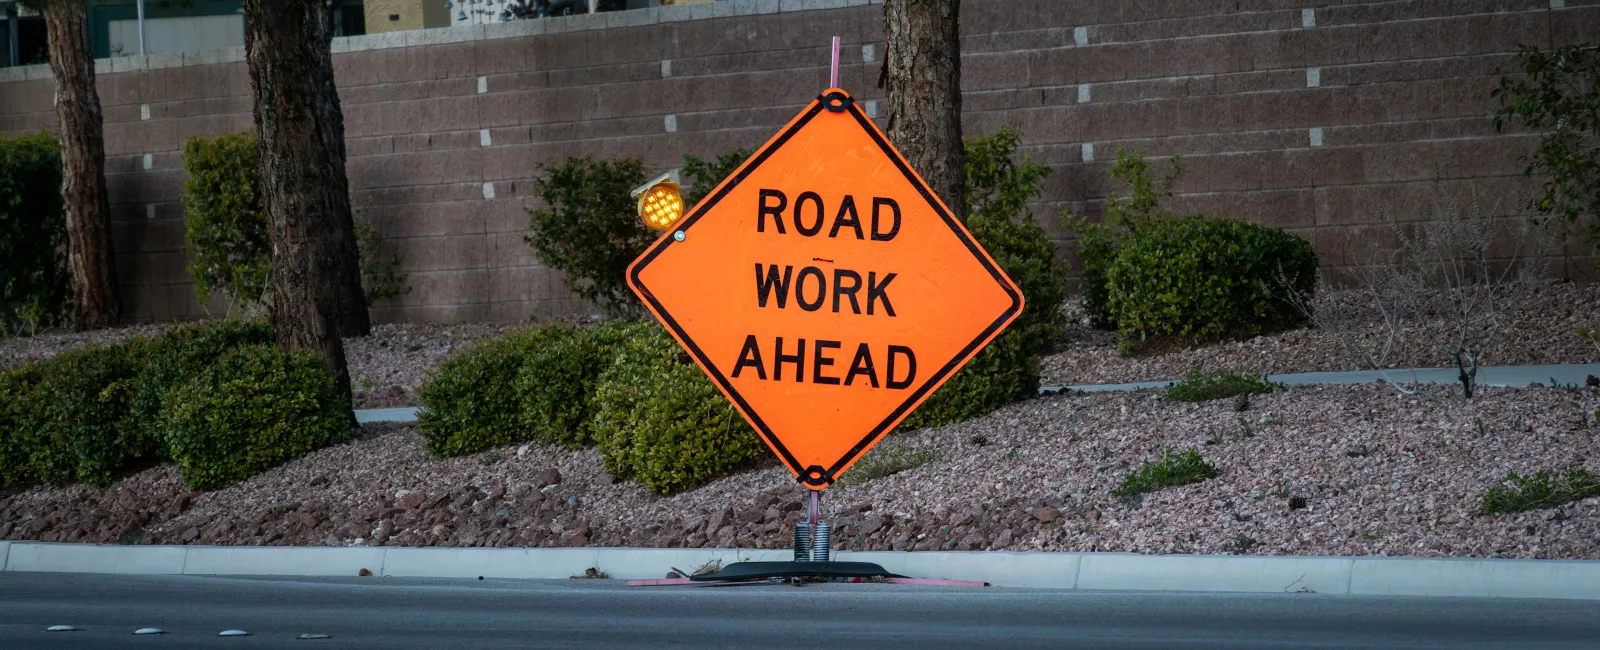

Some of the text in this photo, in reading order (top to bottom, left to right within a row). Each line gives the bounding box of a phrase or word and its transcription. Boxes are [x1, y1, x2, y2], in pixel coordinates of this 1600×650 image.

[757, 188, 902, 242] ROAD
[754, 263, 898, 317] WORK
[731, 334, 917, 390] AHEAD
